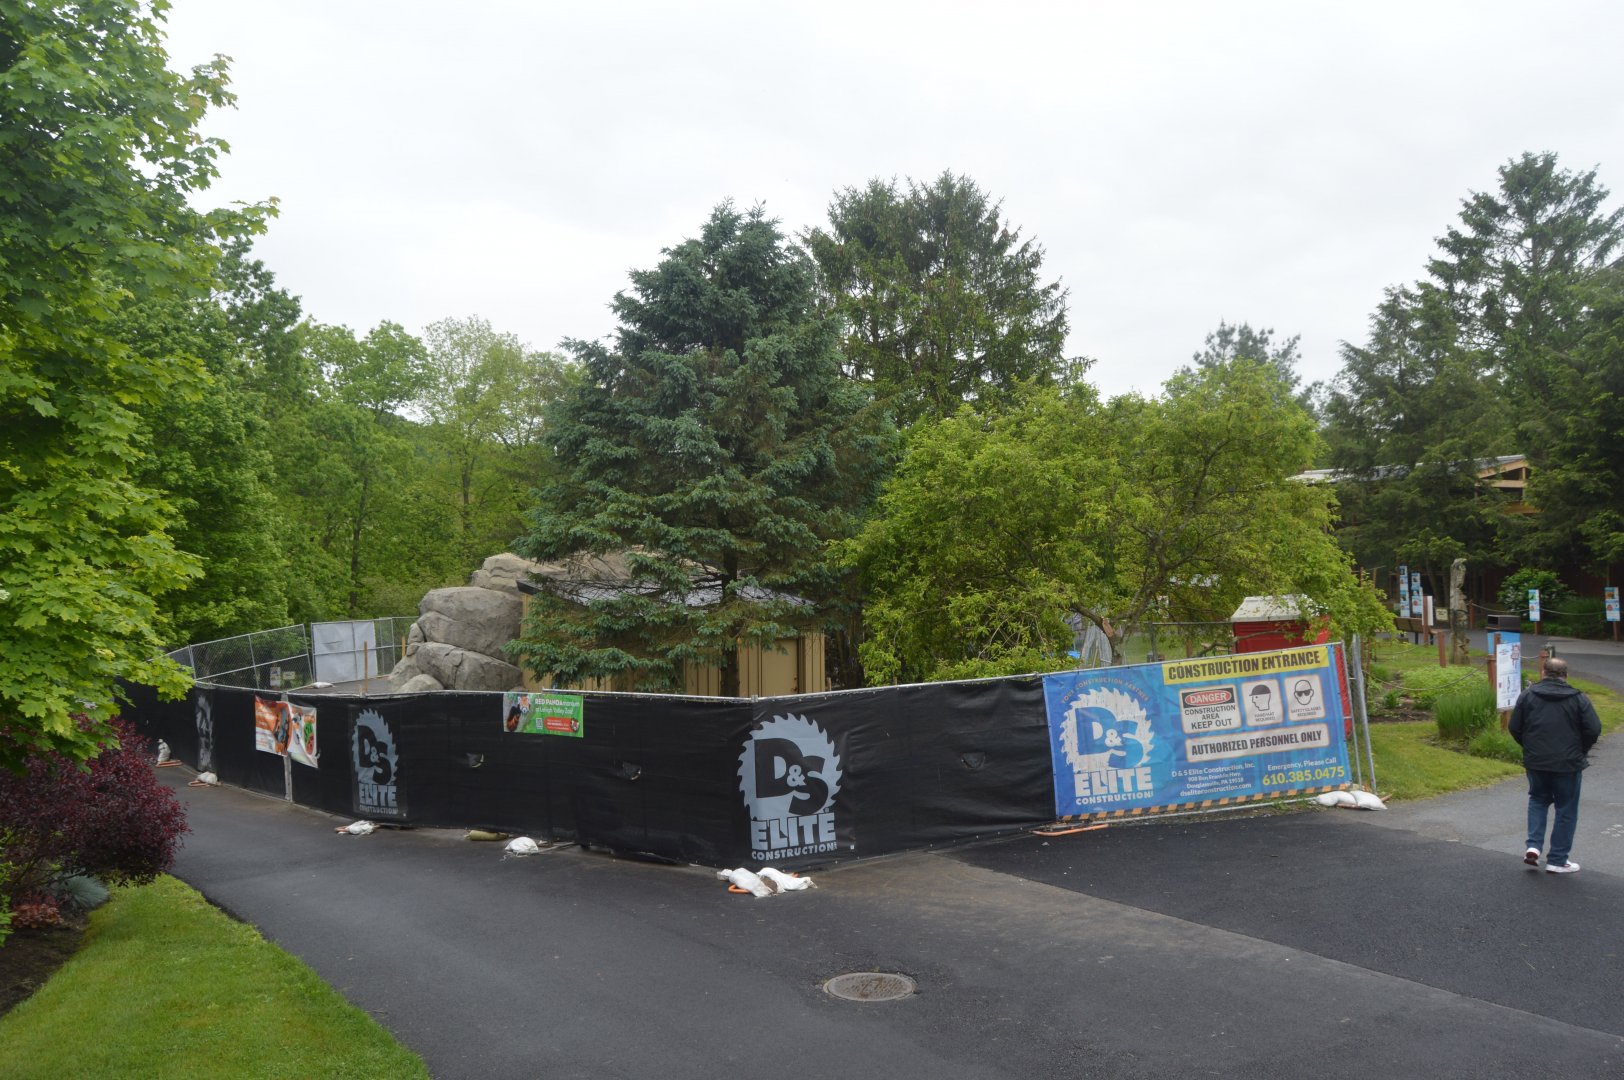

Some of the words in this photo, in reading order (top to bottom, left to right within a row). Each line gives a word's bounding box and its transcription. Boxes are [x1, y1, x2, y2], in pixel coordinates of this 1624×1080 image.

[1169, 657, 1259, 680] CONSTRUCTION
[1262, 650, 1321, 670] ENTRANCE
[1190, 692, 1227, 704] DANGER
[1184, 705, 1236, 716] CONSTRUCTION
[1191, 720, 1213, 730] KEEP
[1215, 718, 1232, 728] OUT
[1075, 706, 1144, 769] D&S
[1191, 740, 1248, 756] AUTHORIZED
[1250, 733, 1299, 749] PERSONNEL
[1301, 730, 1322, 742] ONLY
[1189, 768, 1203, 776] Elite
[1263, 766, 1345, 786] 610.385.0475
[1267, 762, 1303, 771] Emergency,
[754, 738, 829, 816] D&S
[1074, 767, 1153, 797] ELITE
[359, 782, 398, 808] ELITE
[1076, 791, 1152, 805] CONSTRUCTION
[751, 812, 836, 850] ELITE
[751, 843, 835, 861] CONSTRUCTION
